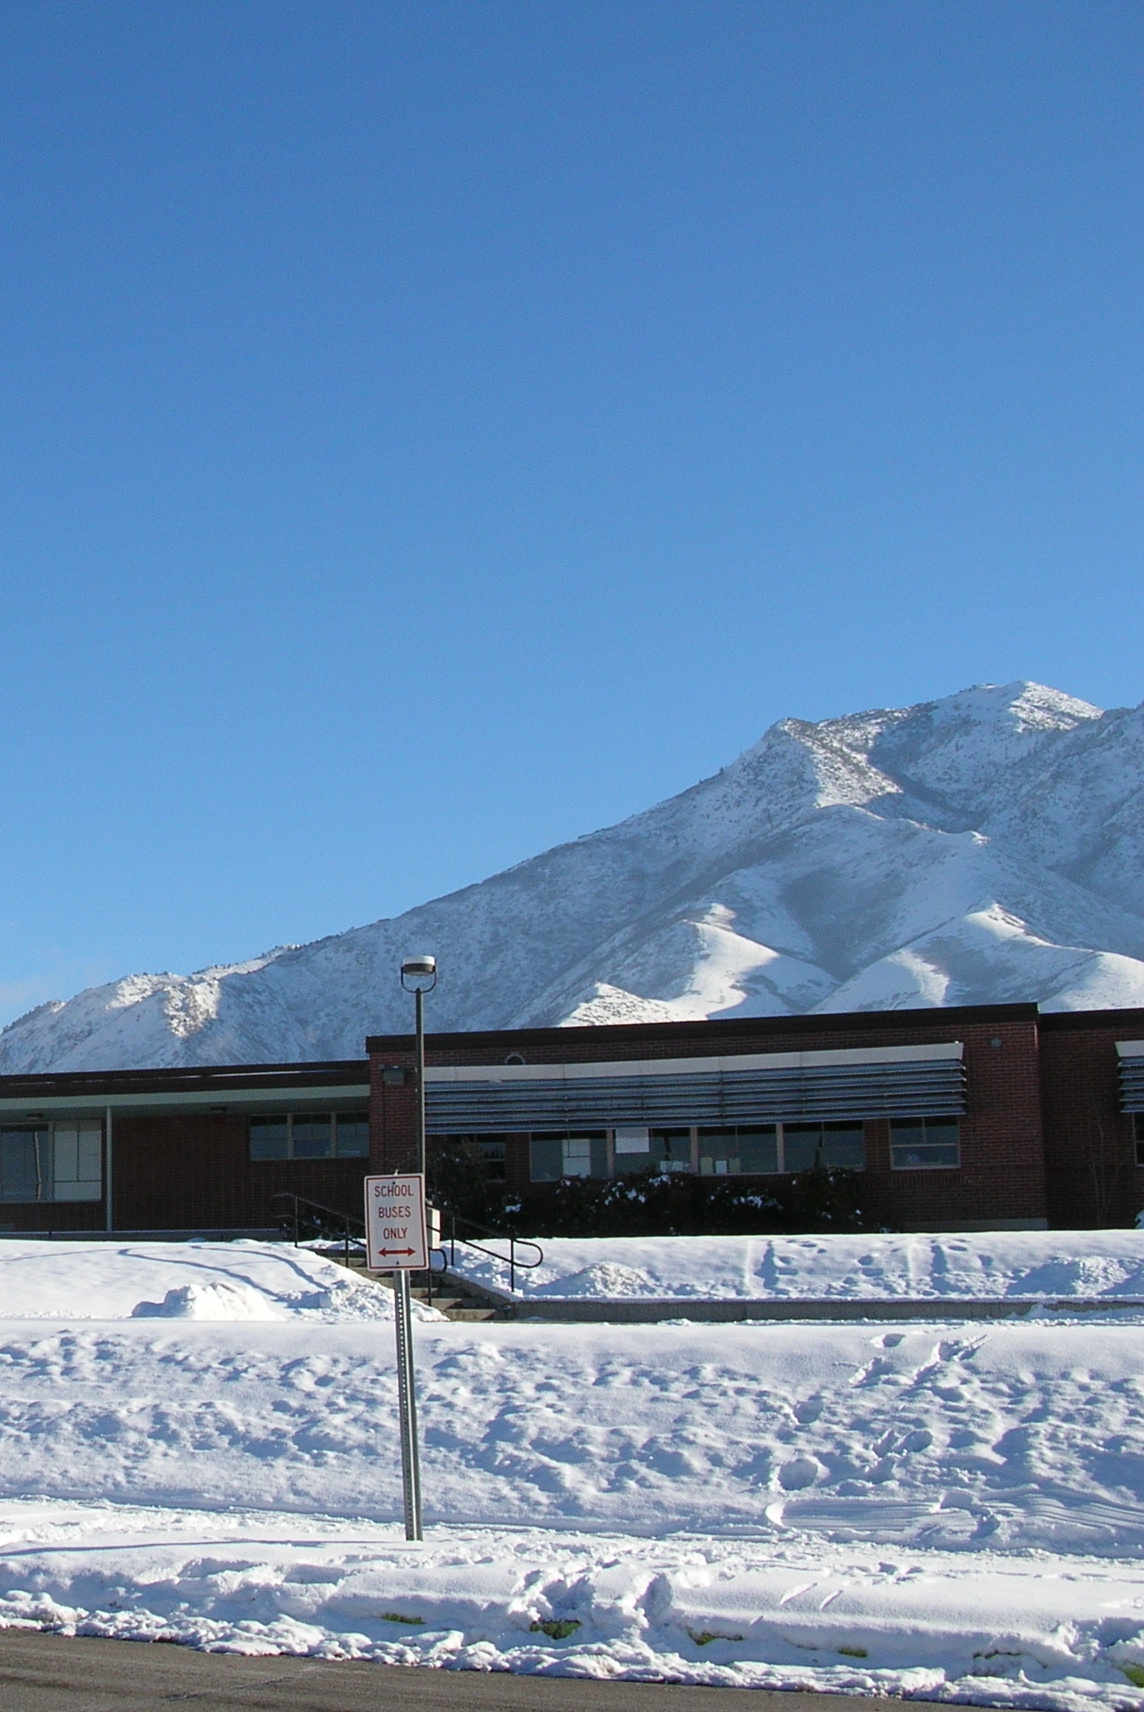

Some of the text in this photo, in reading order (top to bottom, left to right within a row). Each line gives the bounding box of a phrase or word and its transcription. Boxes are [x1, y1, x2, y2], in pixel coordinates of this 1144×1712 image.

[374, 1185, 413, 1197] SCHOOL
[378, 1206, 411, 1218] BUSES
[383, 1228, 408, 1239] ONLY
